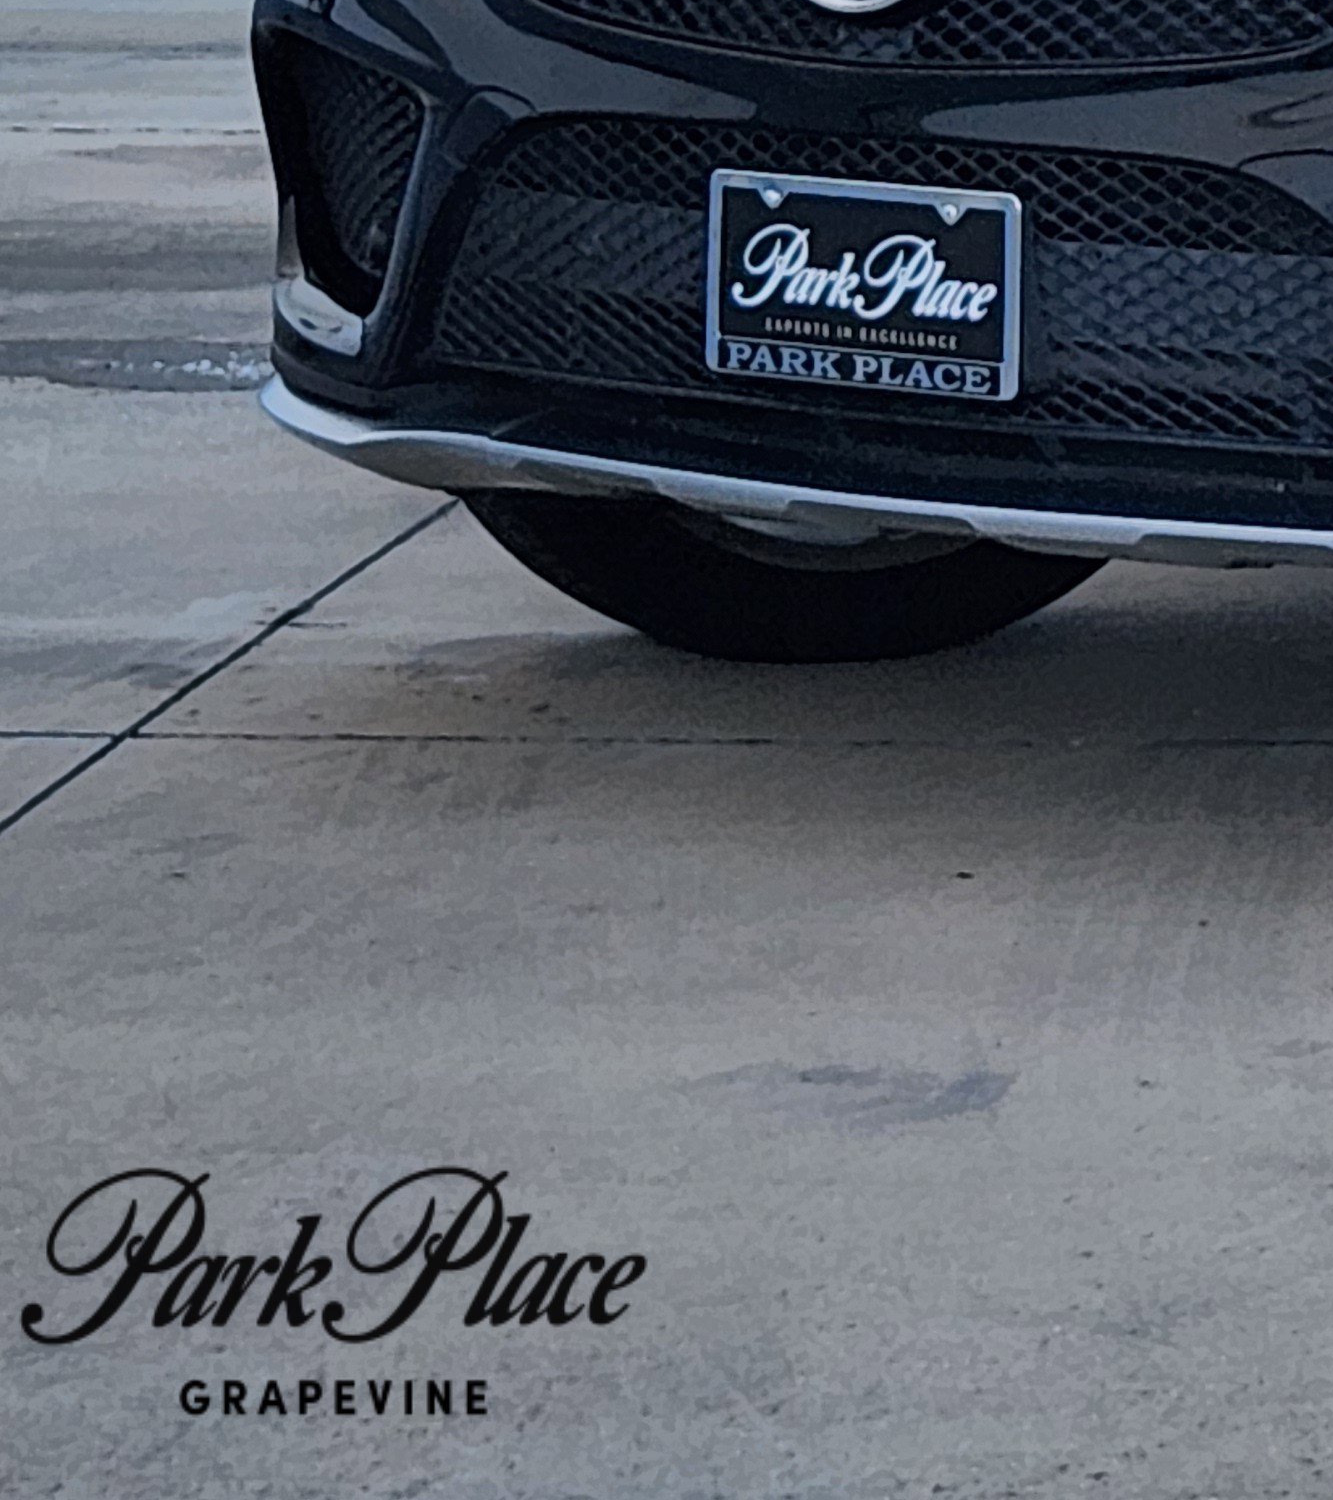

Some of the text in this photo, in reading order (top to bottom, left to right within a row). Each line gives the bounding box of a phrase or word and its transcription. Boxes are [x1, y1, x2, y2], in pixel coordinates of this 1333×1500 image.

[731, 222, 998, 322] Park Place
[726, 341, 992, 394] PARK PLACE
